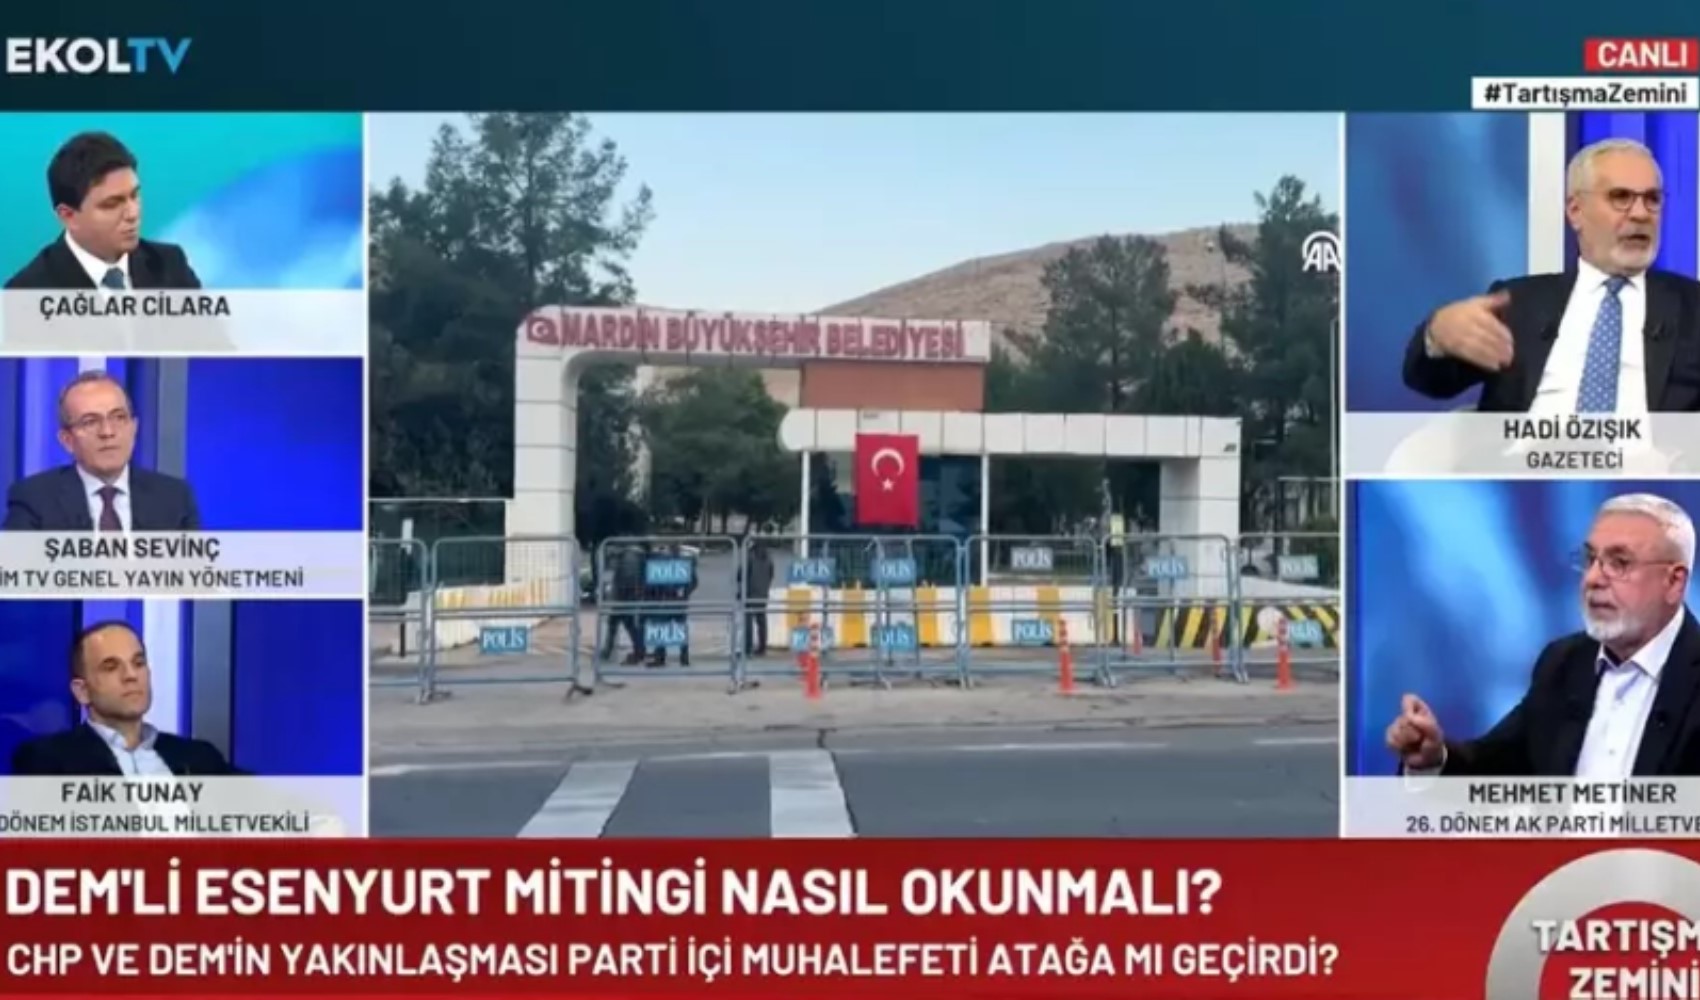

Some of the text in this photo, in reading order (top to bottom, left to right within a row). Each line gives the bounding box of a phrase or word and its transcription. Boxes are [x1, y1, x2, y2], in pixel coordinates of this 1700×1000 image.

[563, 309, 965, 358] MARDİN BÜYÜKŞEHİR BELEDİYESİ
[650, 561, 688, 580] POLİS
[482, 627, 524, 649] POLİS
[645, 620, 685, 642] POLİS
